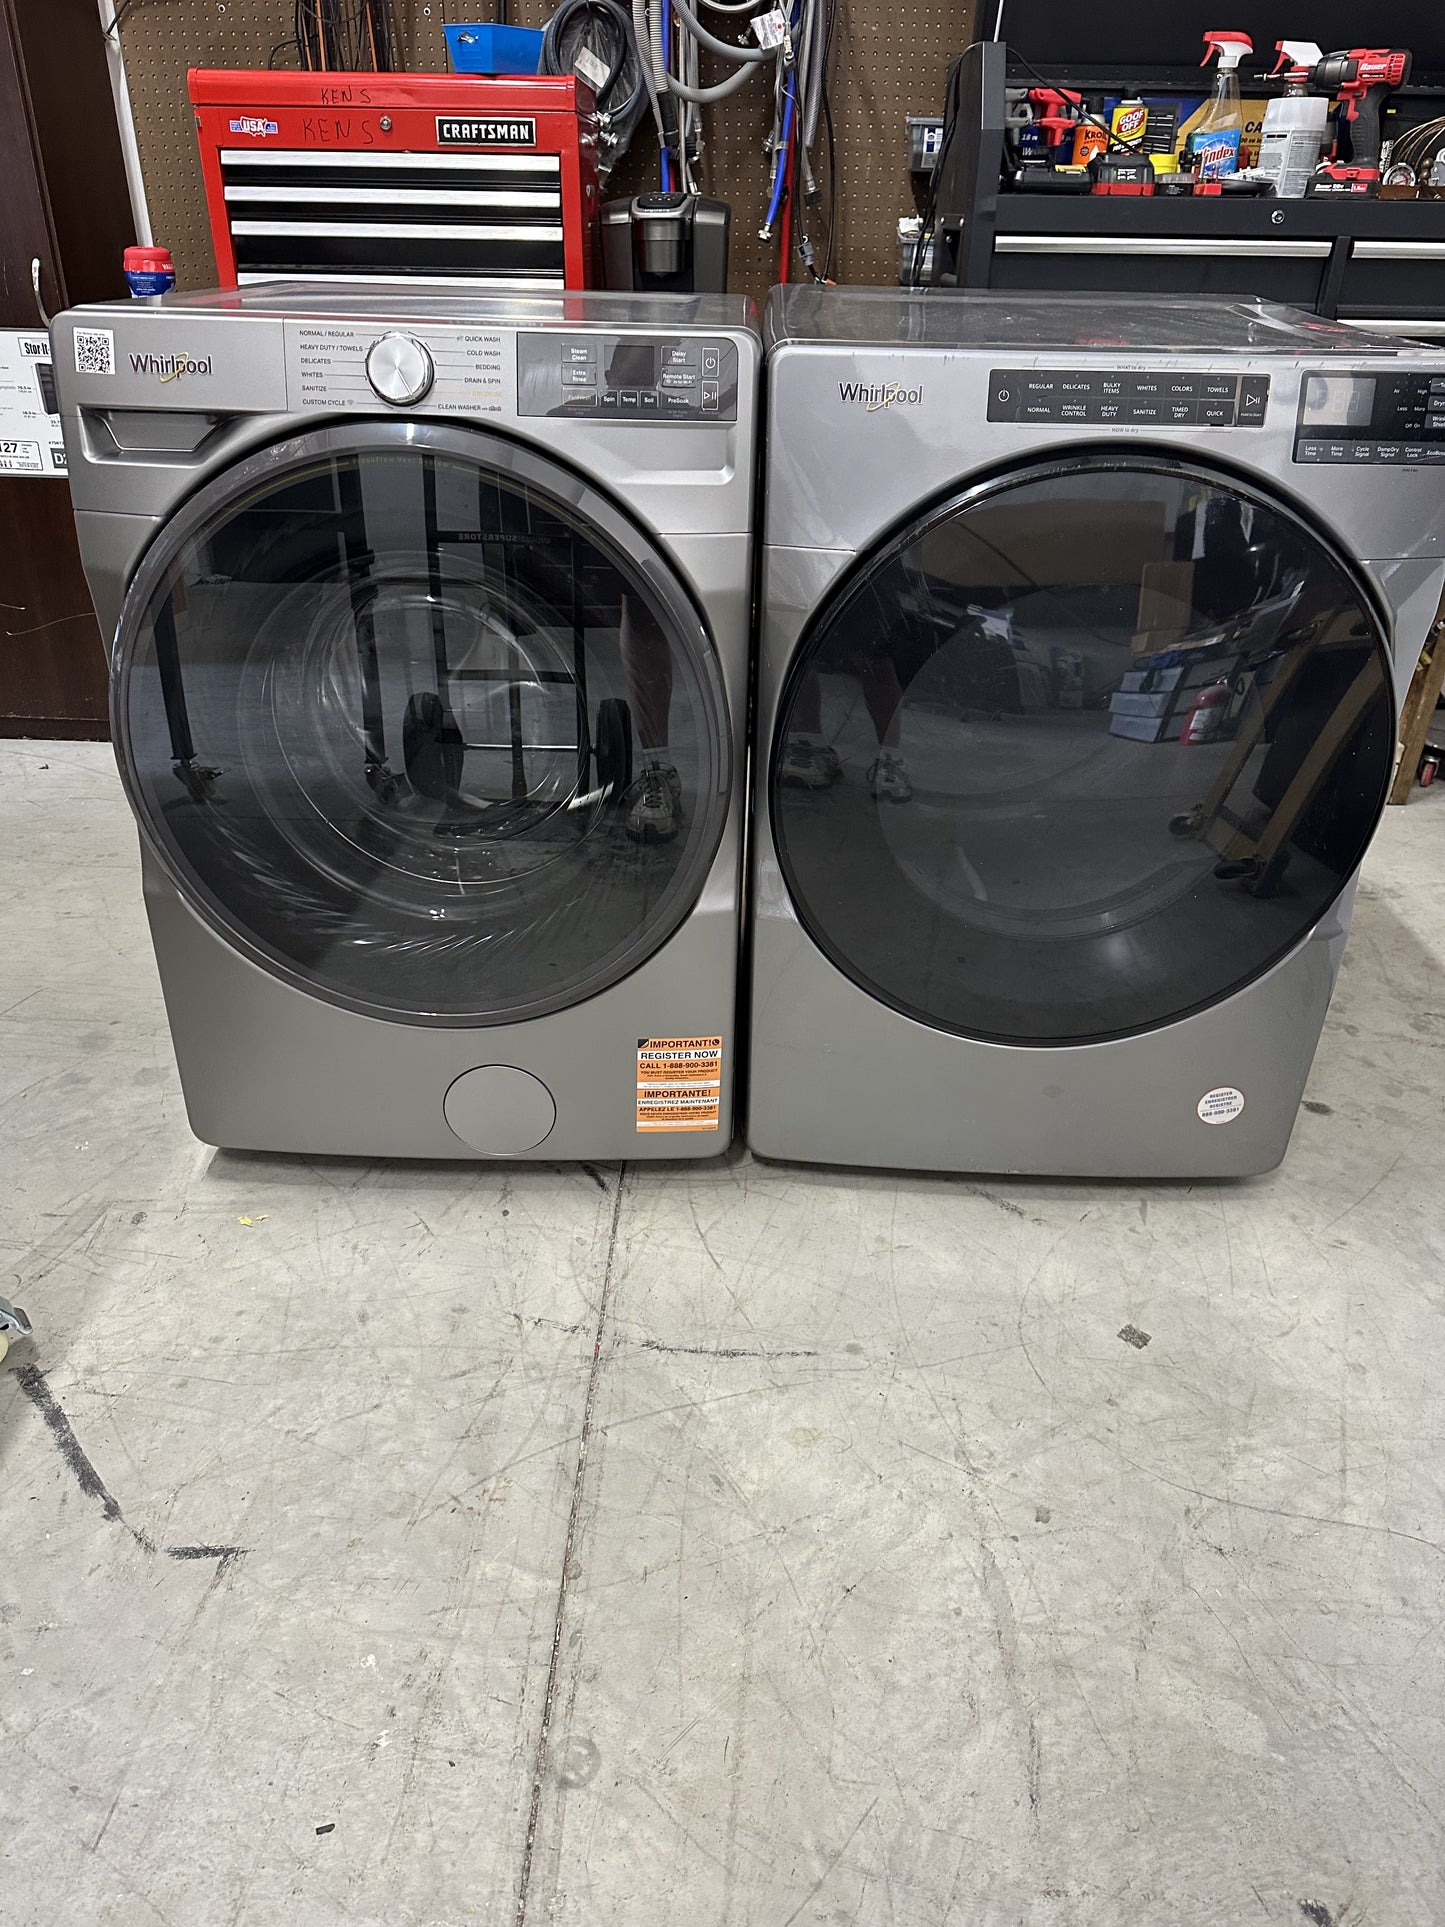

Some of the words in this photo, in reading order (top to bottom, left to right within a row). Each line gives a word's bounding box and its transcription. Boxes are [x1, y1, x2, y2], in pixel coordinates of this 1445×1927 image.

[1119, 109, 1144, 124] GOOF
[242, 119, 264, 132] USA
[1121, 120, 1140, 132] OFF
[442, 123, 529, 140] CRAFTSMAN
[327, 330, 355, 338] REGULAR
[483, 335, 501, 343] WASH
[466, 349, 483, 357] COLD
[570, 347, 588, 355] Steam
[671, 350, 687, 358] Delay
[129, 353, 213, 380] Whirlpool
[1062, 383, 1090, 391] DELICATES
[603, 395, 616, 403] Spin
[622, 396, 637, 404] Temp
[838, 382, 924, 408] Whirlpool
[302, 398, 327, 406] CUSTOM
[437, 403, 457, 411] CLEAN
[1027, 406, 1051, 414] NORMAL
[1377, 446, 1400, 454] DampDry
[650, 1038, 712, 1049] IMPORTANT!
[640, 1051, 692, 1060] REGISTER
[694, 1050, 719, 1059] NOW
[663, 1060, 718, 1069] 1-888-900-3381
[644, 1089, 711, 1098] IMPORTANTE!
